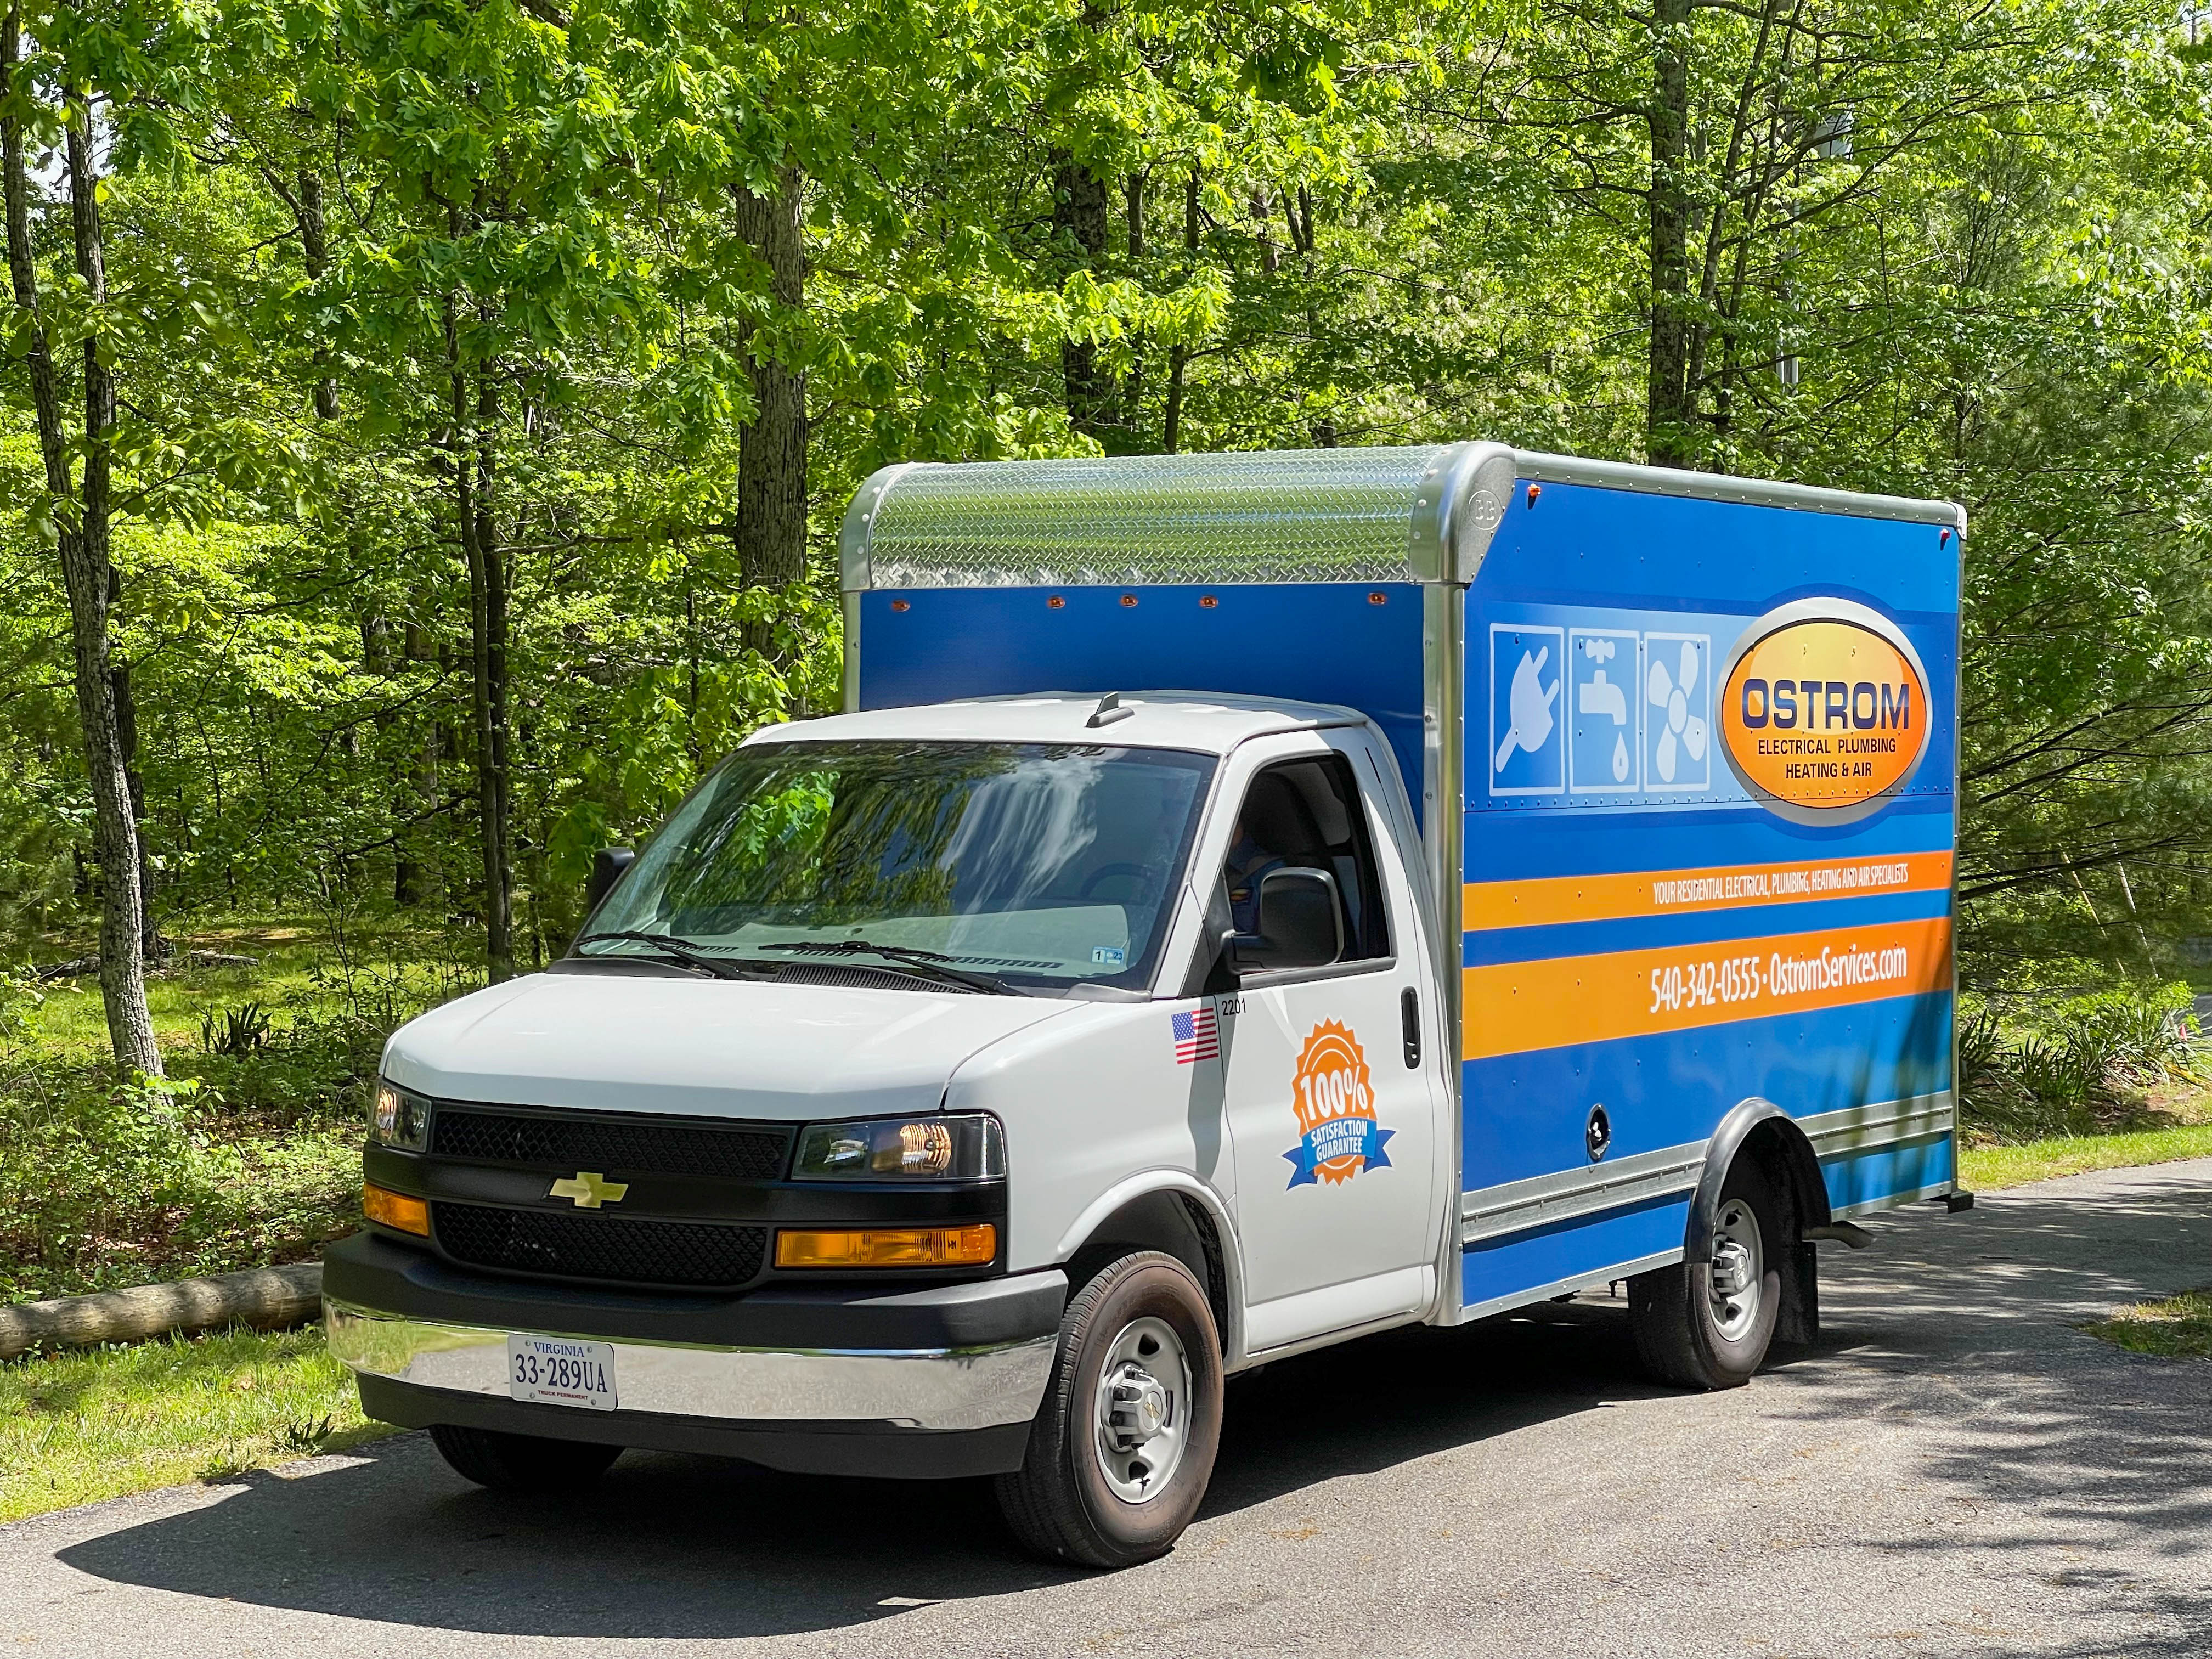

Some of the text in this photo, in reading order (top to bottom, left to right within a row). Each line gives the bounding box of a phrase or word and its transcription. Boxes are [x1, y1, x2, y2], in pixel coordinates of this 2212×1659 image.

[1742, 678, 1910, 730] OSTROM
[1758, 738, 1896, 755] ELECTRICAL PLUMBING
[1786, 762, 1872, 779] HEATING & AIR
[1653, 863, 1908, 905] YOUR RESIDENTIAL ELECTRICAL, PLUMBING, HEATING AND AIR SPECIALISTS
[1095, 951, 1101, 960] 1
[1650, 943, 1907, 1013] 540-342-0555 OstromServices.com
[1221, 997, 1246, 1016] 2201
[1300, 1065, 1368, 1120] 100%
[1311, 1120, 1368, 1147] SATISFACTION
[1316, 1137, 1363, 1162] GUARANTEE
[534, 1342, 584, 1357] VIRGINIA
[516, 1353, 608, 1392] 33-289UA
